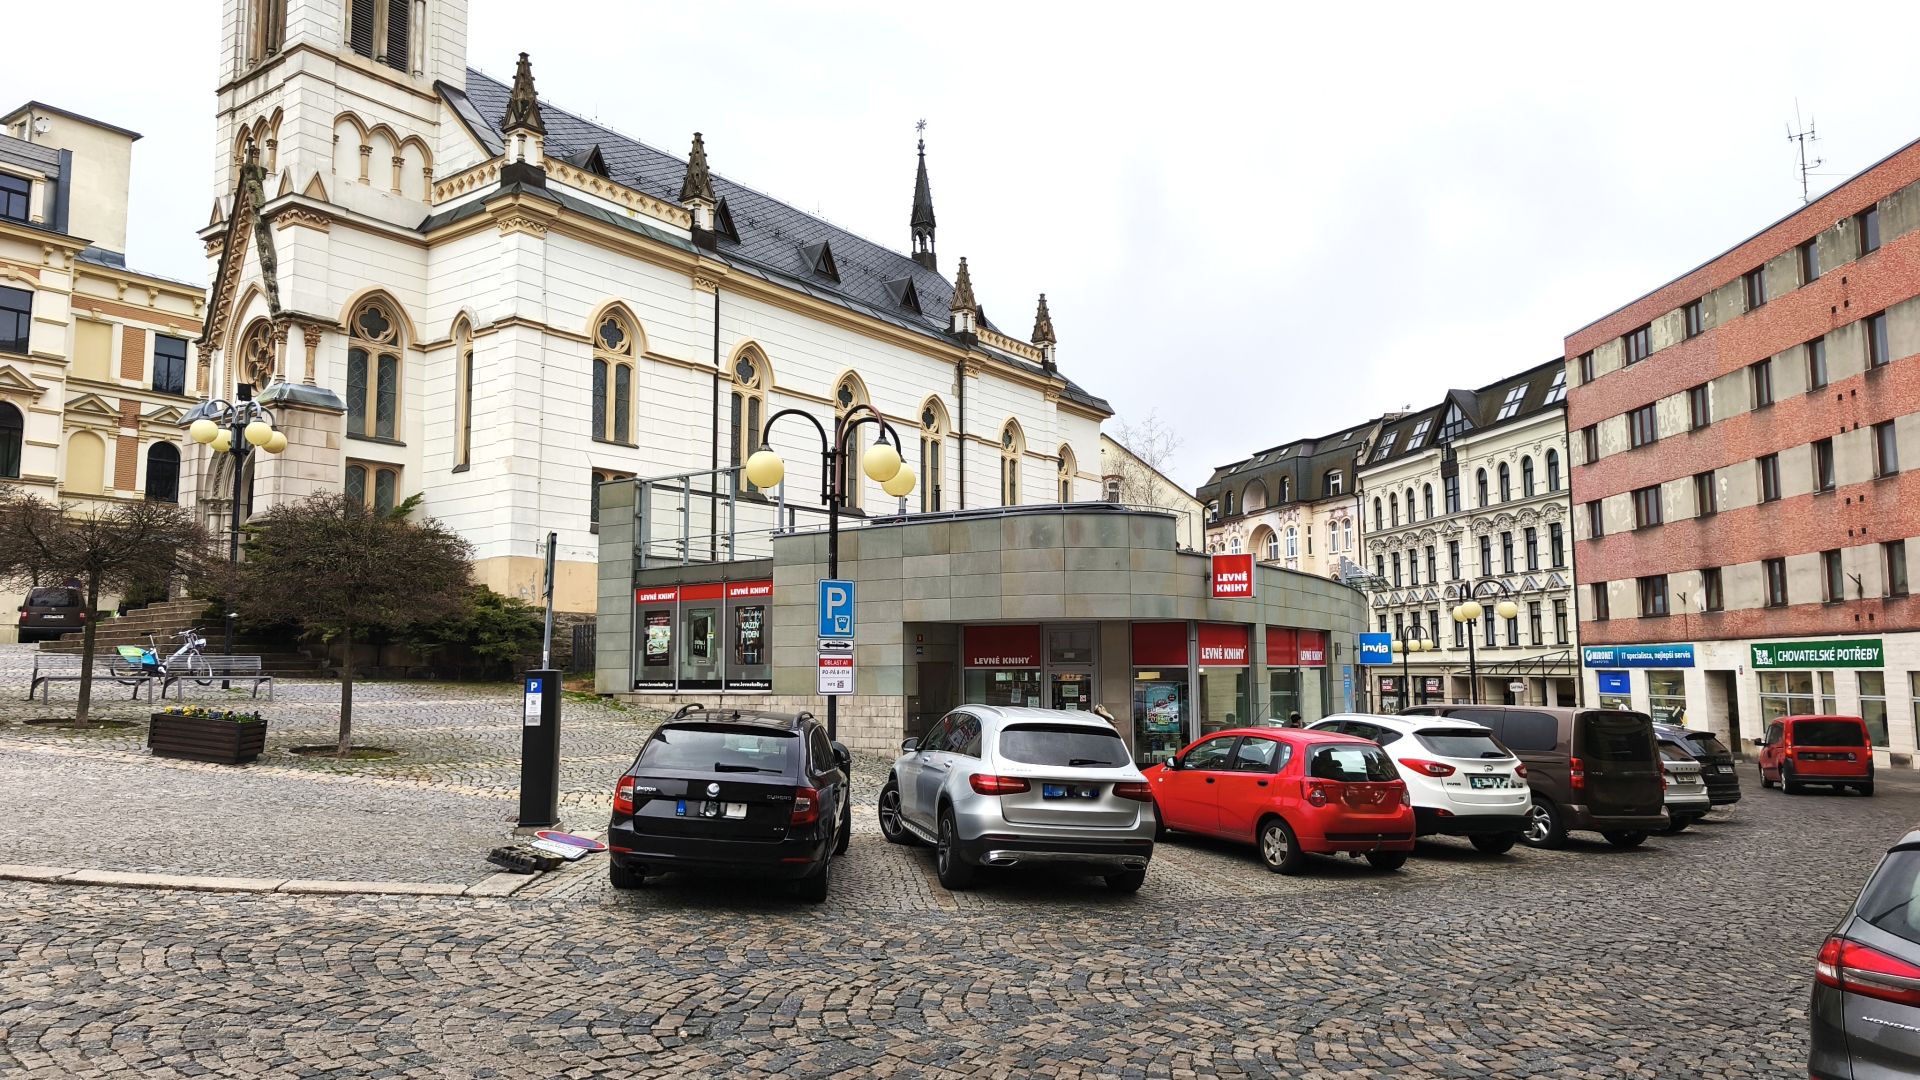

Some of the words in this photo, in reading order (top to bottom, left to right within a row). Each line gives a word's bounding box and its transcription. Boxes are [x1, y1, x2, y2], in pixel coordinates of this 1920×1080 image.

[1217, 571, 1248, 582] LEVNÉ
[731, 586, 748, 595] LEVNÉ
[750, 587, 769, 595] KNIHY
[1216, 583, 1248, 593] KNIHY
[640, 592, 656, 601] LEVNÉ
[827, 587, 847, 619] P
[1201, 645, 1222, 660] LEVNÉ
[1224, 648, 1244, 660] KNIHY
[1362, 643, 1389, 653] invia
[1300, 649, 1312, 661] LEVNÉ
[1311, 651, 1323, 660] KNIHY
[1592, 651, 1613, 660] MIRONET
[1654, 651, 1674, 660] nejlepší
[1674, 650, 1691, 658] servis
[1777, 647, 1835, 662] CHOVATELSKÉ
[1837, 646, 1880, 660] POTŘEBY
[974, 656, 1000, 665] LEVNÉ
[1002, 657, 1030, 665] KNIHY
[530, 681, 538, 692] P
